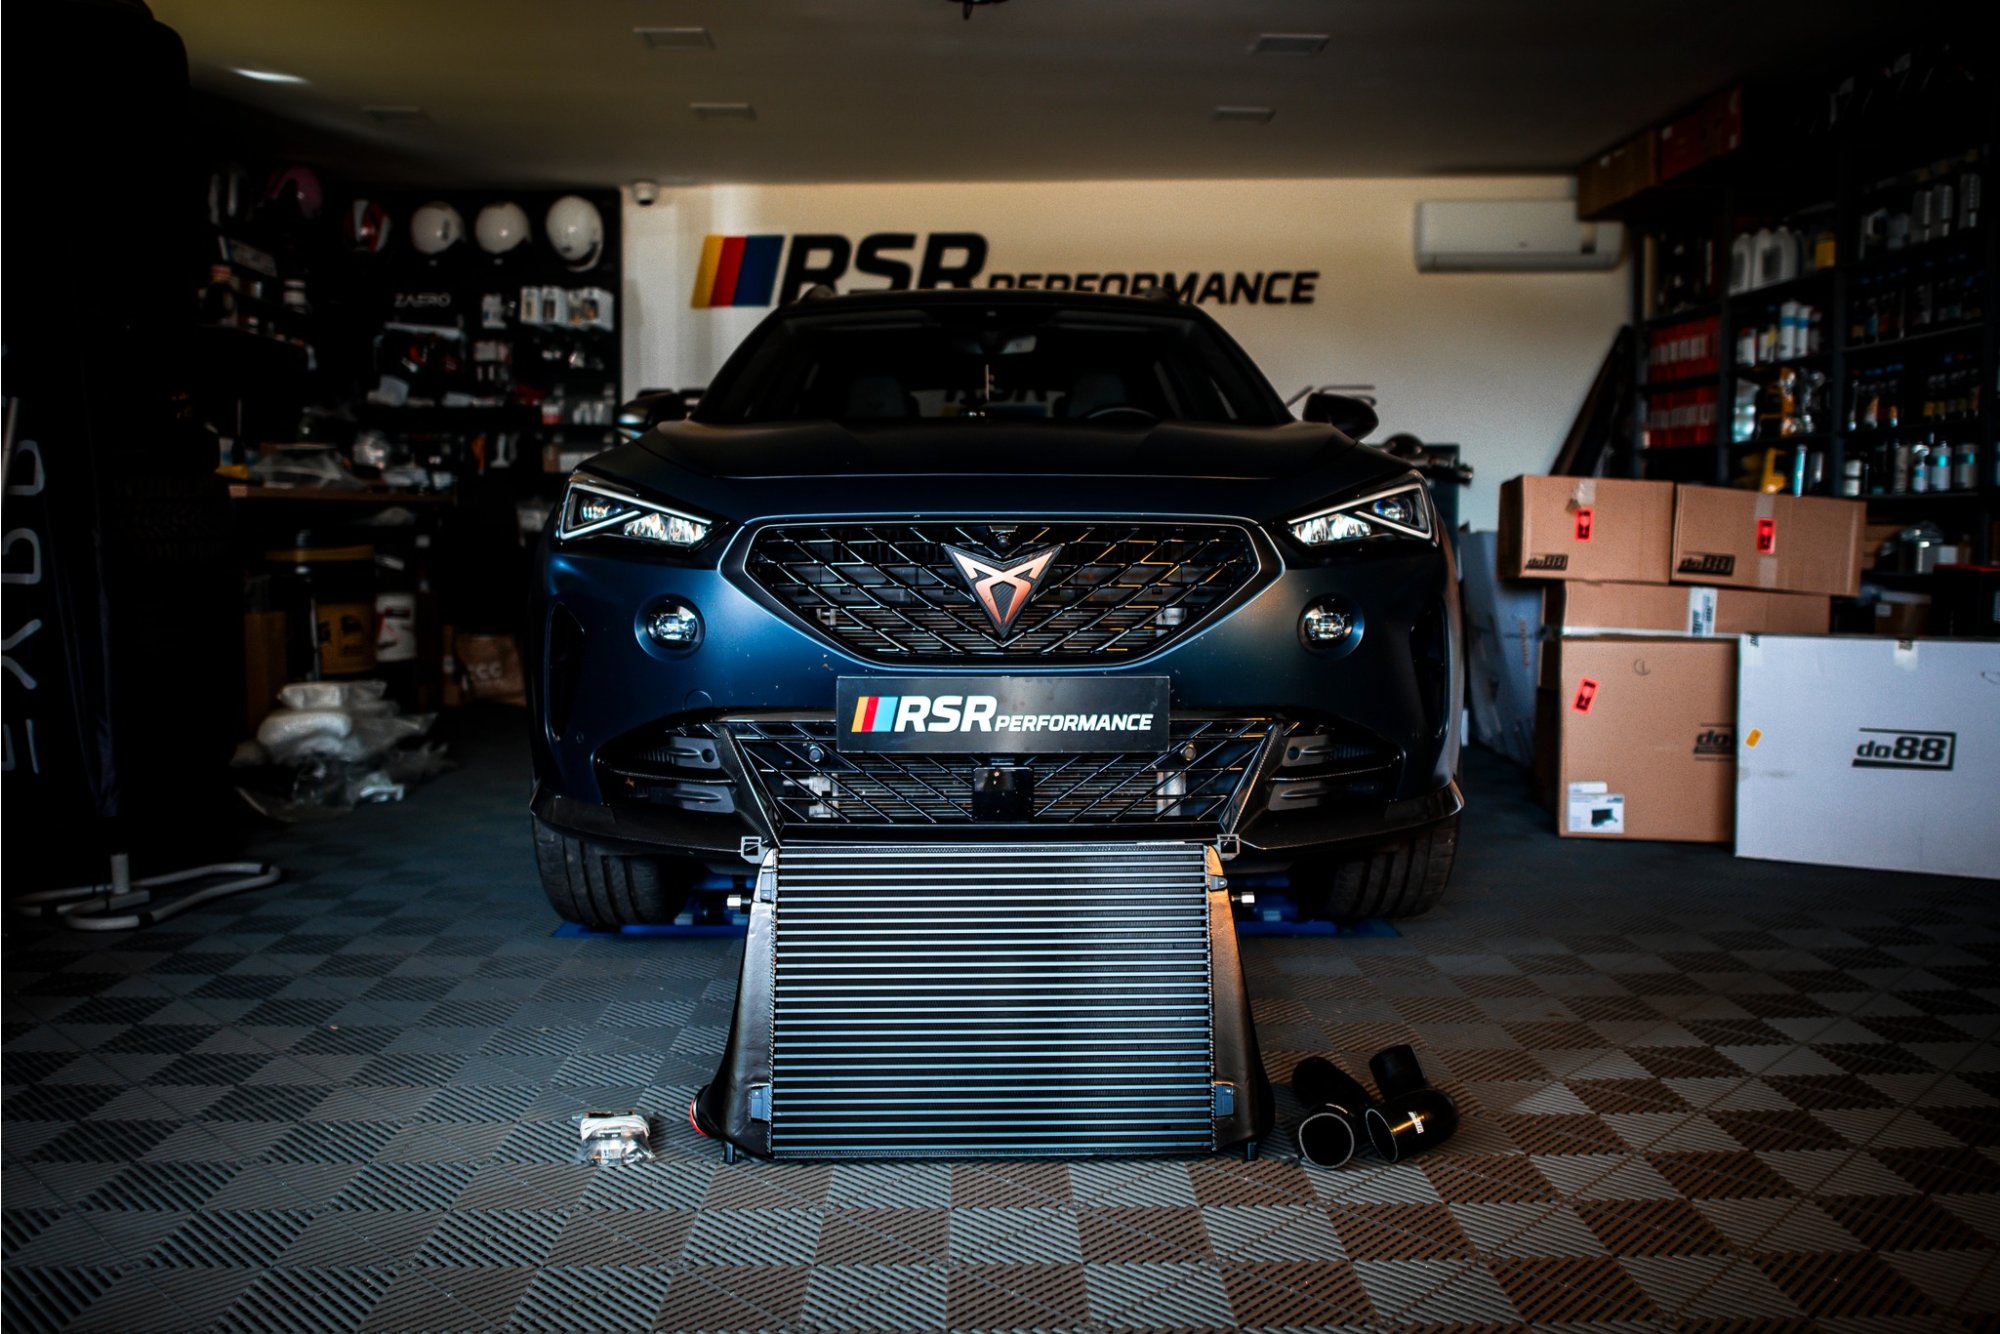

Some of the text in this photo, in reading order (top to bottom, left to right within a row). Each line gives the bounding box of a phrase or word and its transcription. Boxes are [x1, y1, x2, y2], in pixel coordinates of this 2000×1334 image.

[781, 233, 988, 303] RSR
[894, 695, 1153, 732] RSR PERFORMANCE
[1857, 736, 1948, 763] do88
